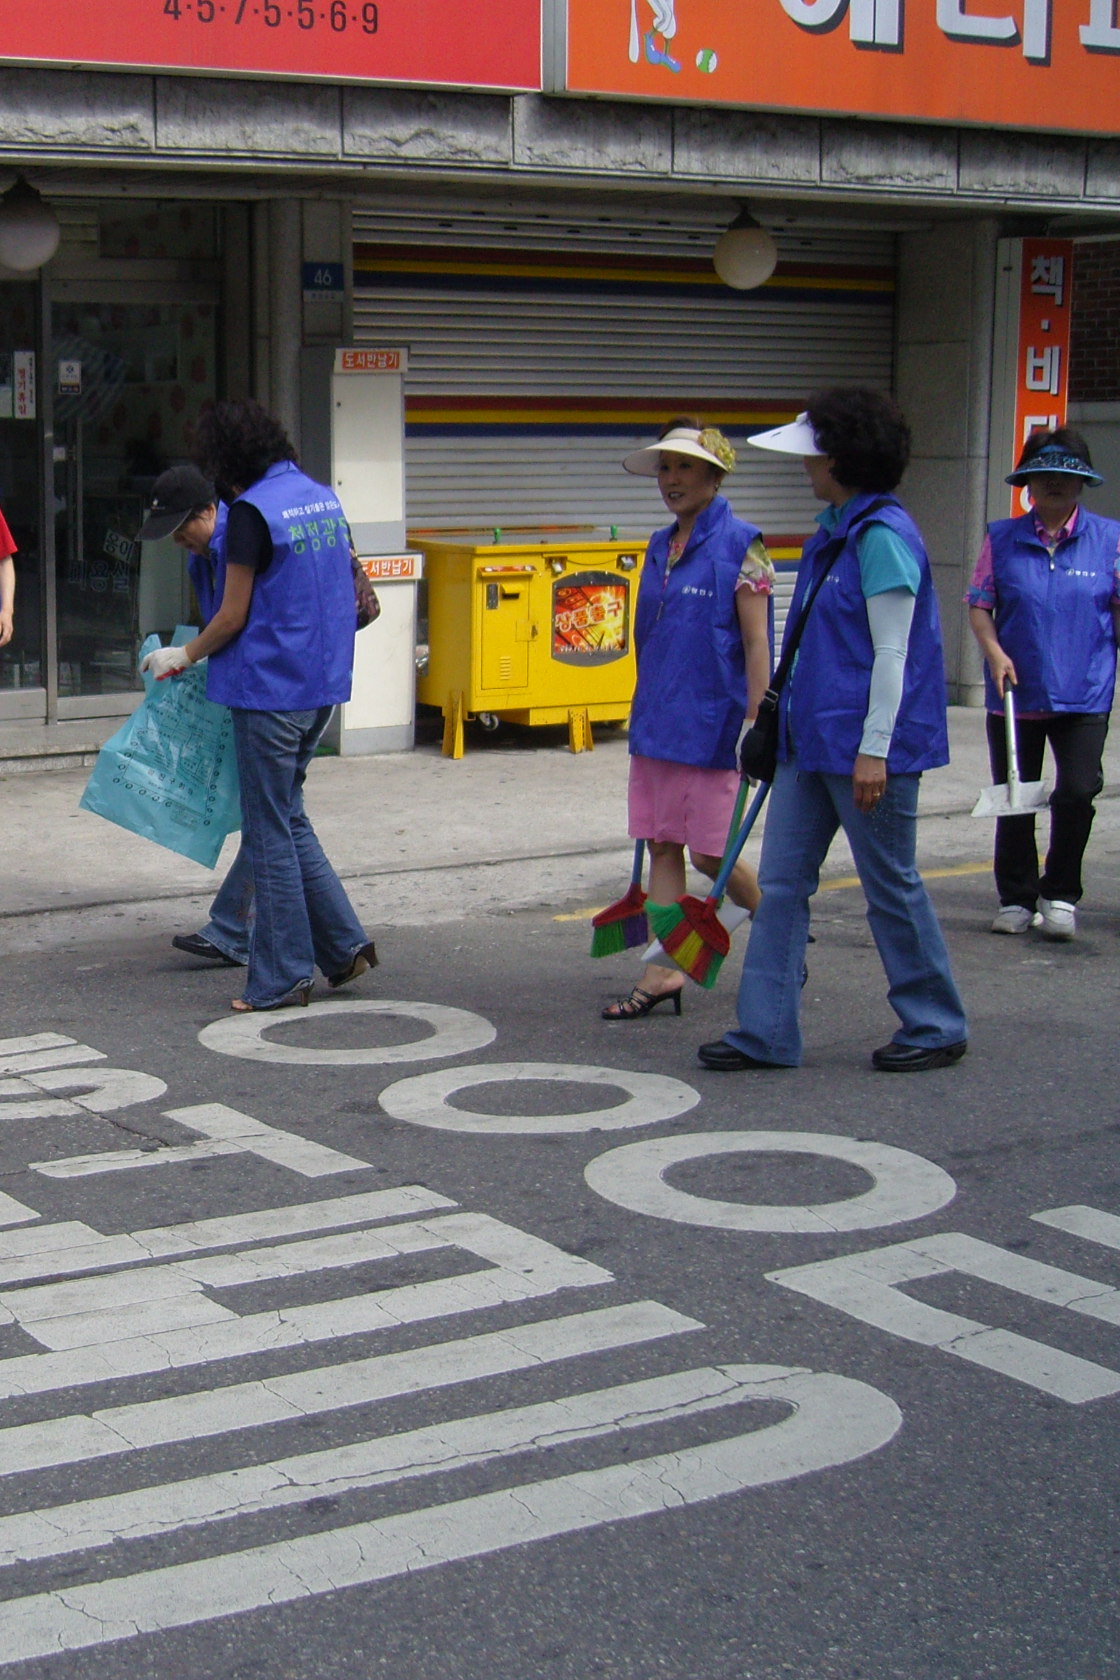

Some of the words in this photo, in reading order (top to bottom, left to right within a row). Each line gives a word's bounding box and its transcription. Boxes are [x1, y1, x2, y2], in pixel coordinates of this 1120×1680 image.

[314, 268, 332, 287] 46
[345, 352, 397, 369] 도서반납기
[68, 560, 130, 593] 미용실
